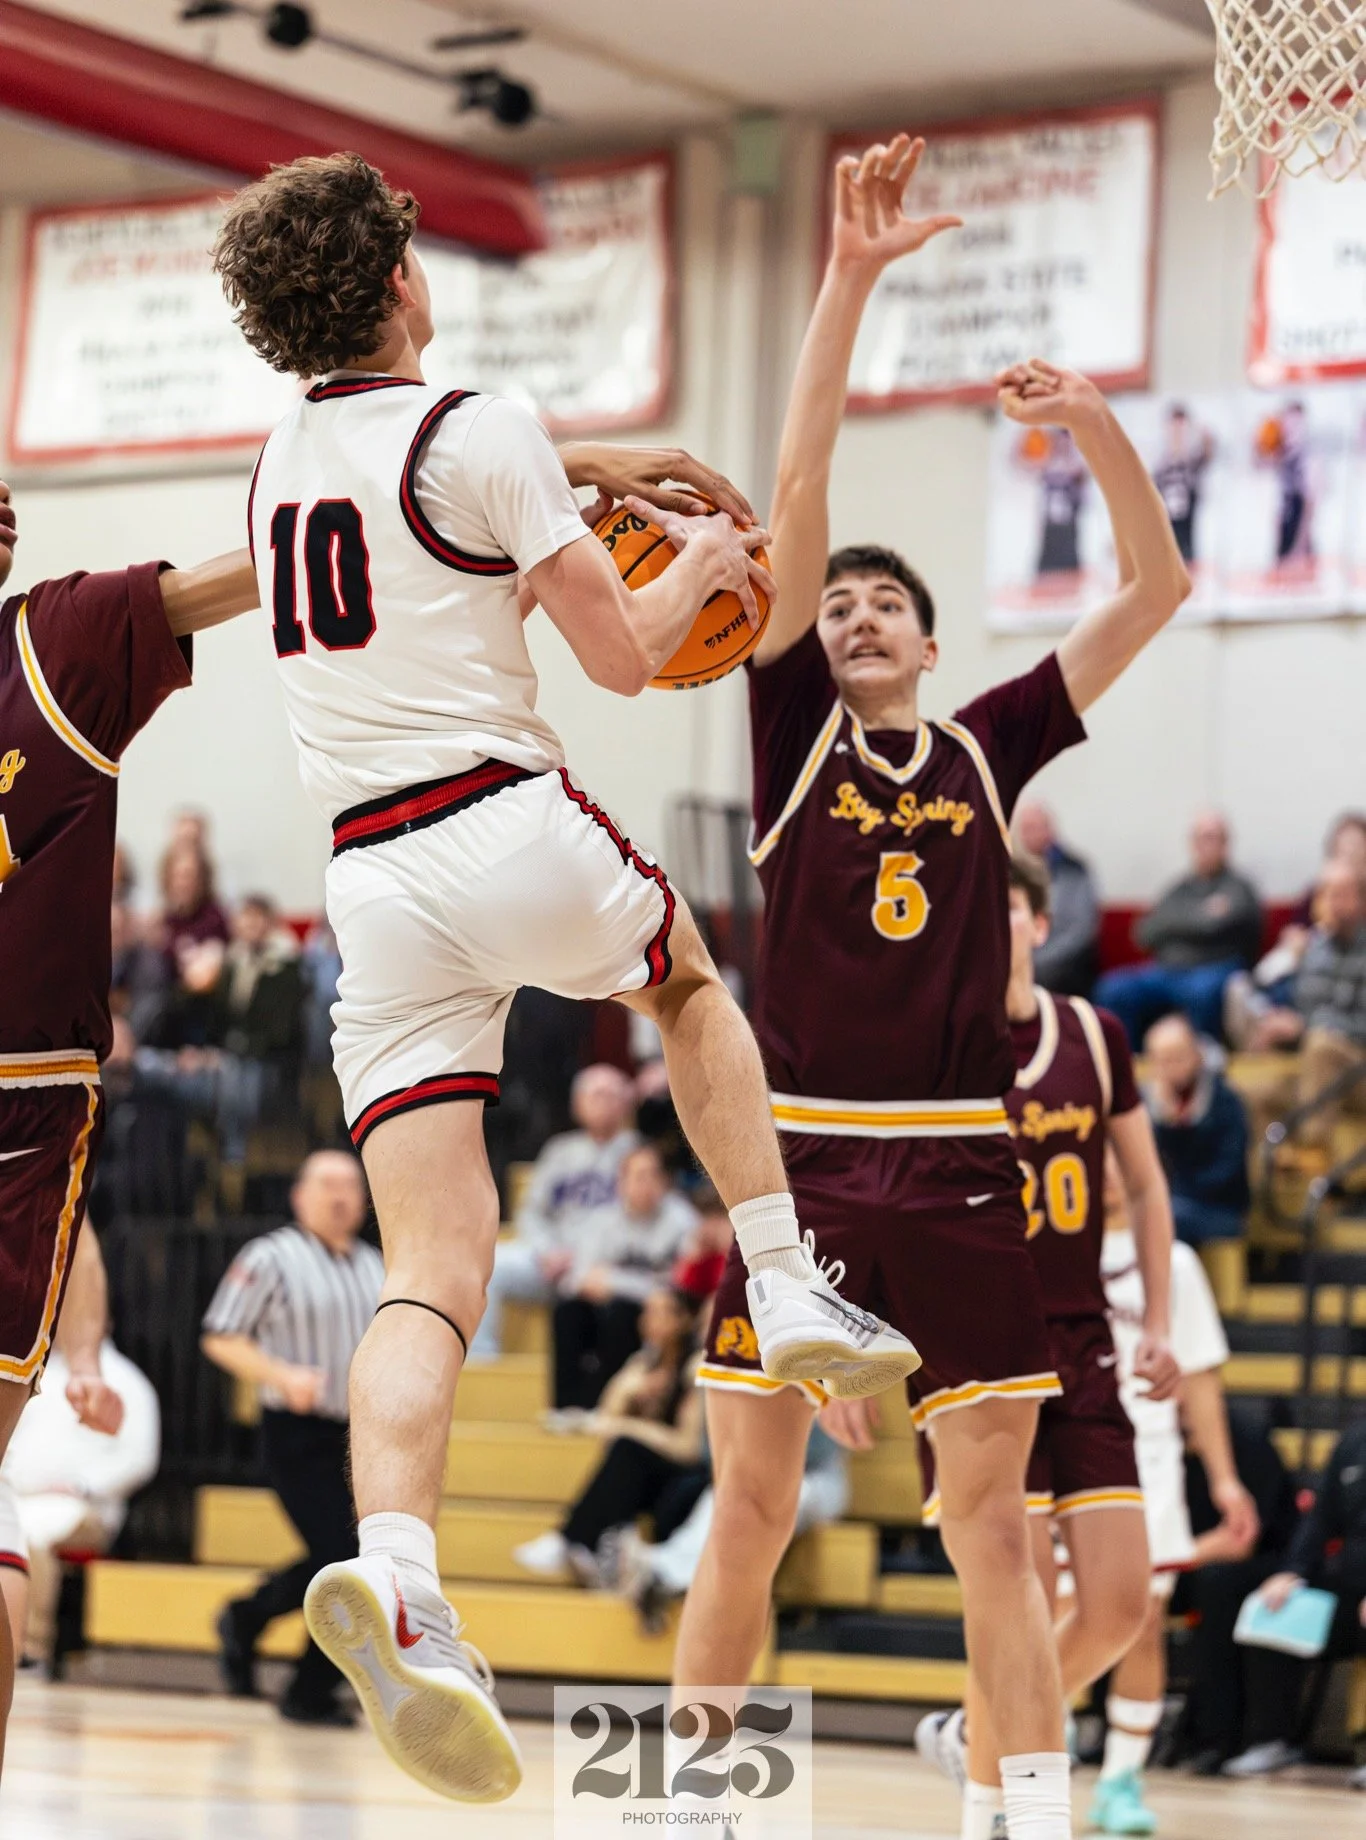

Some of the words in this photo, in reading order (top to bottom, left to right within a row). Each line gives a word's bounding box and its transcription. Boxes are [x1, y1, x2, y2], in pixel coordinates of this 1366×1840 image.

[270, 498, 377, 658] 10
[714, 610, 748, 643] NFHS
[829, 781, 886, 835] Big
[890, 791, 975, 836] Spring
[871, 851, 932, 941] 5
